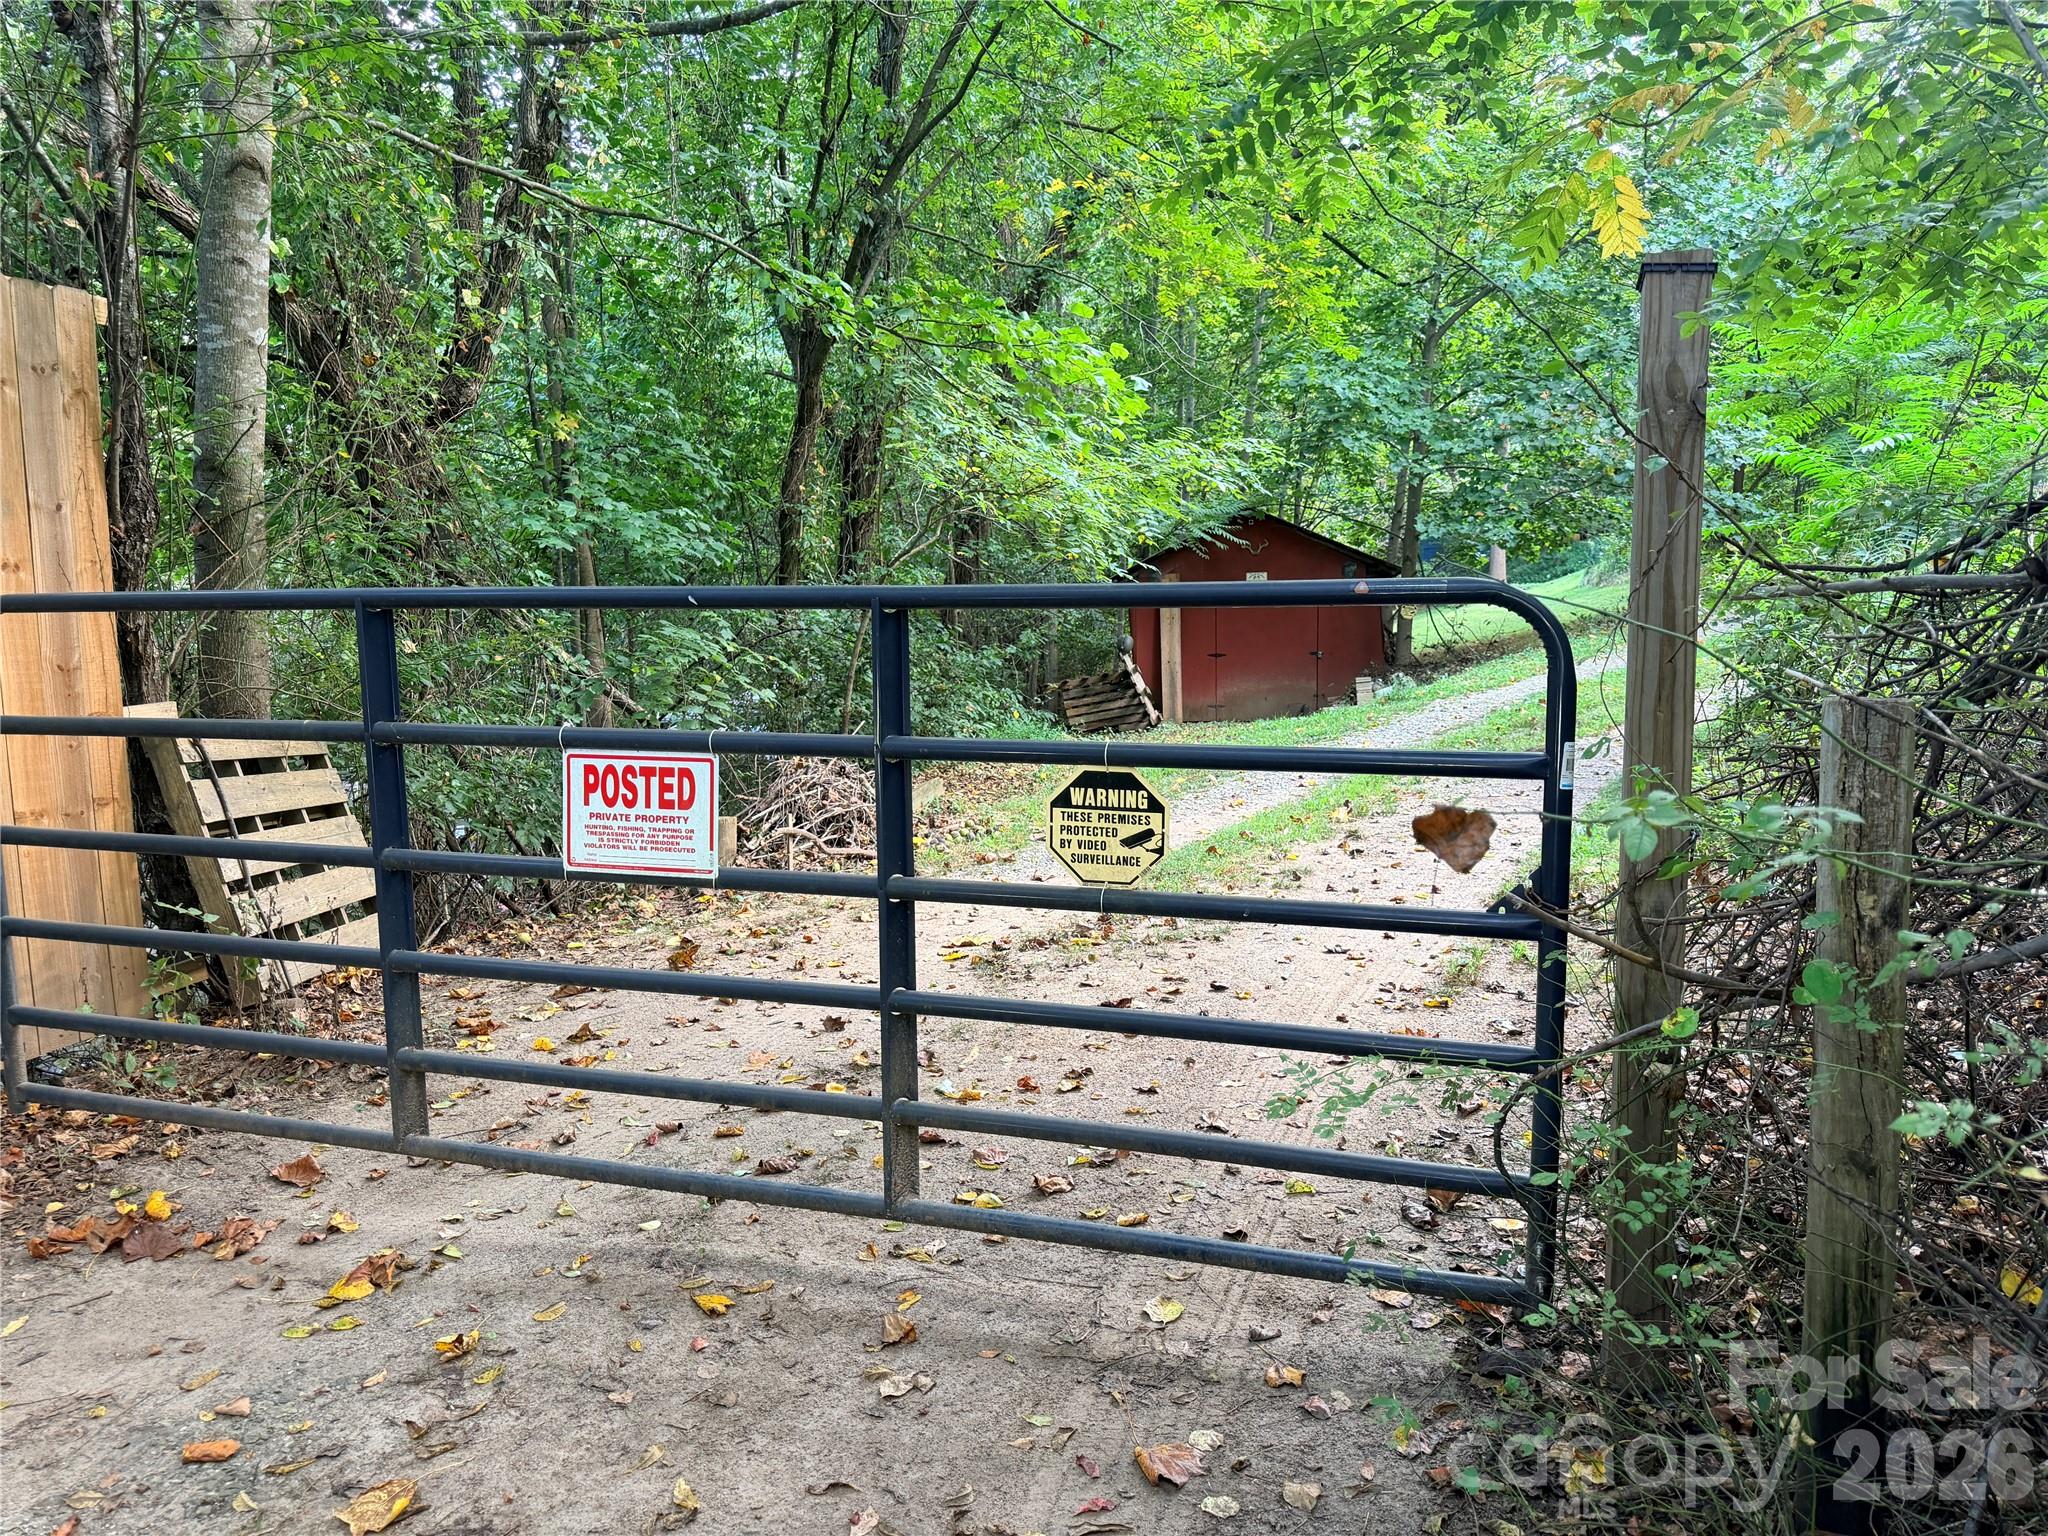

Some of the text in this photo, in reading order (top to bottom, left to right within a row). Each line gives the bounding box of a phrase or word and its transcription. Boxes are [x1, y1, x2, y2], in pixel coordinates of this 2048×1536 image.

[584, 764, 696, 811] POSTED
[1069, 787, 1148, 809] WARNING
[589, 812, 689, 824] PRIVATE PROPERTY
[1060, 811, 1151, 826] THESE PREMISES
[1060, 825, 1118, 838] PROTECTED
[650, 846, 696, 854] PROSECUTED
[1060, 838, 1107, 851] BY VIDEO
[1070, 853, 1141, 867] SURVEILLANCE
